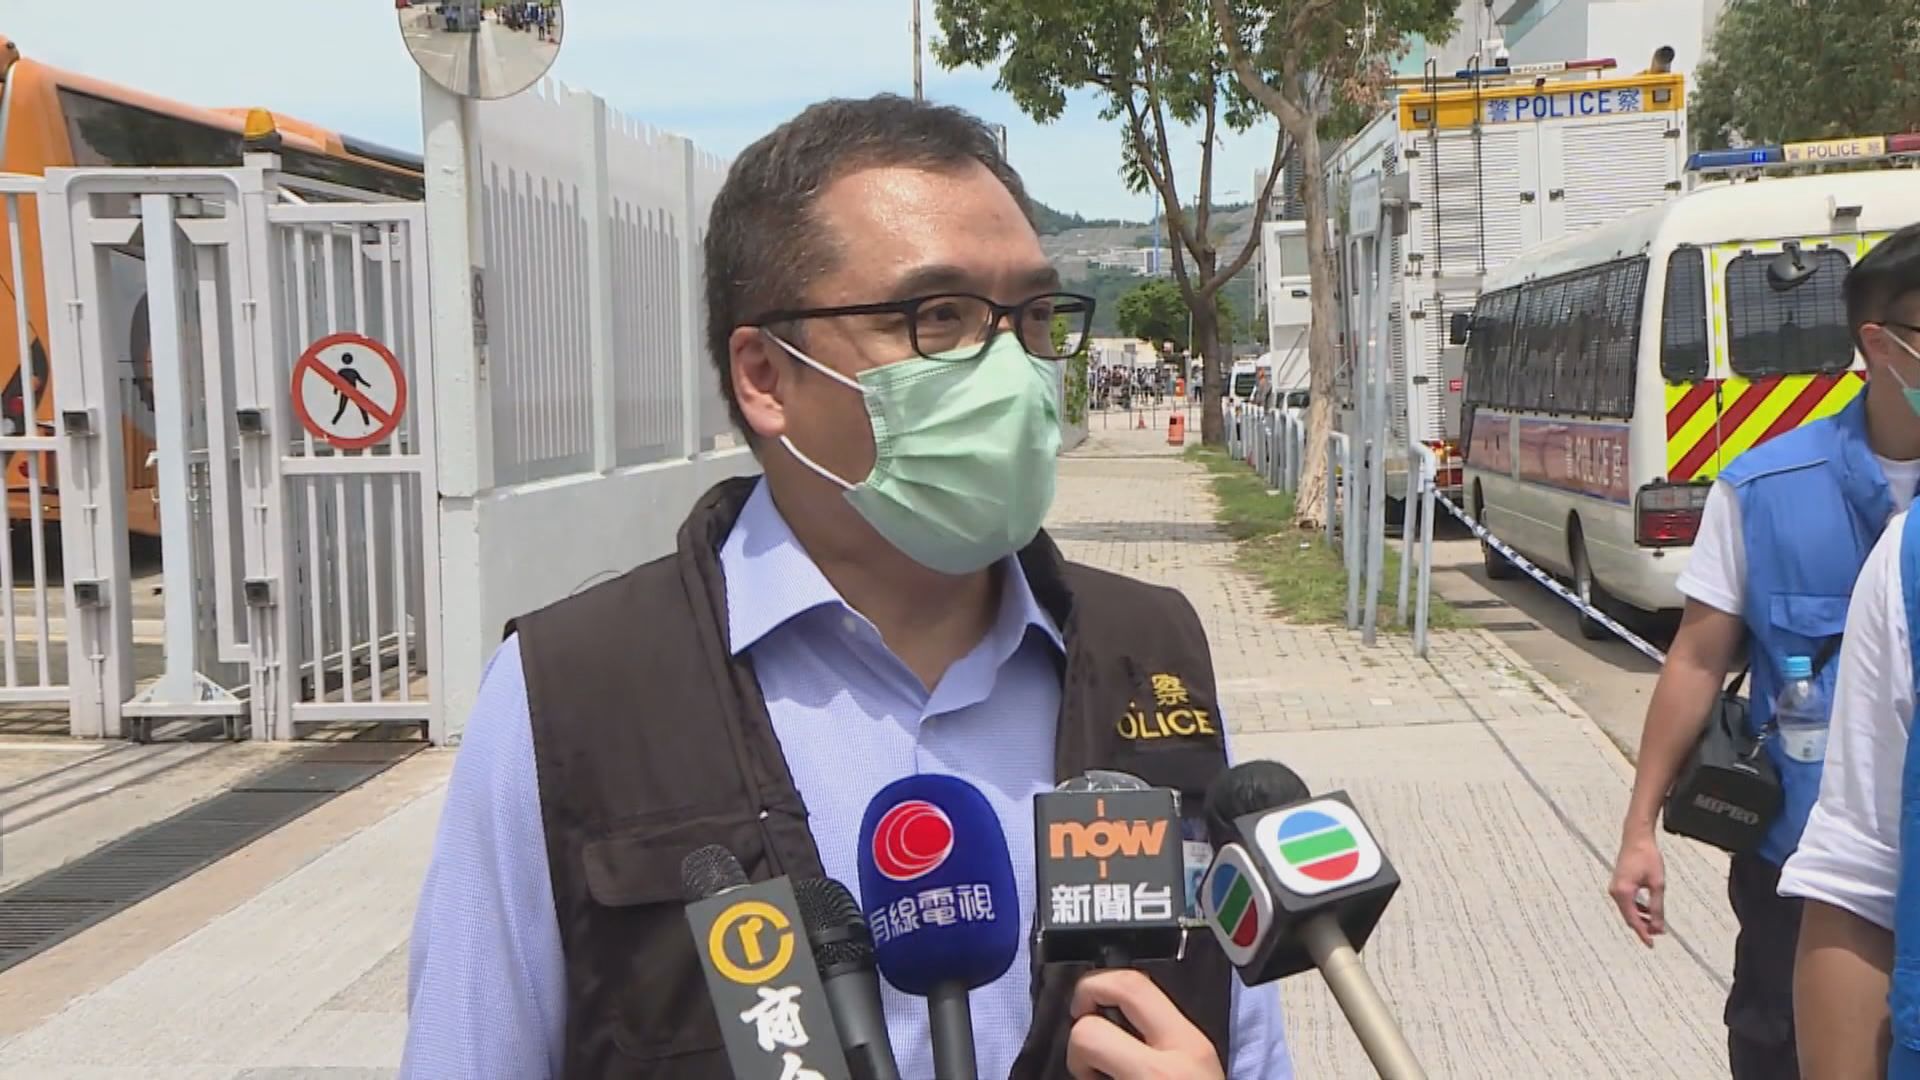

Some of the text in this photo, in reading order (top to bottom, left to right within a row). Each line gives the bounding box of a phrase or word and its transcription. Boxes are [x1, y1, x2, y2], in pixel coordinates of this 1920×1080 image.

[1516, 89, 1612, 120] POLICE
[1617, 88, 1640, 112] 察
[1807, 142, 1860, 159] POLICE
[1117, 708, 1215, 740] OLICE
[1695, 793, 1760, 826] MIPRO
[1049, 819, 1168, 859] now
[869, 883, 996, 944] 有線電視
[1051, 882, 1172, 924] 新聞台
